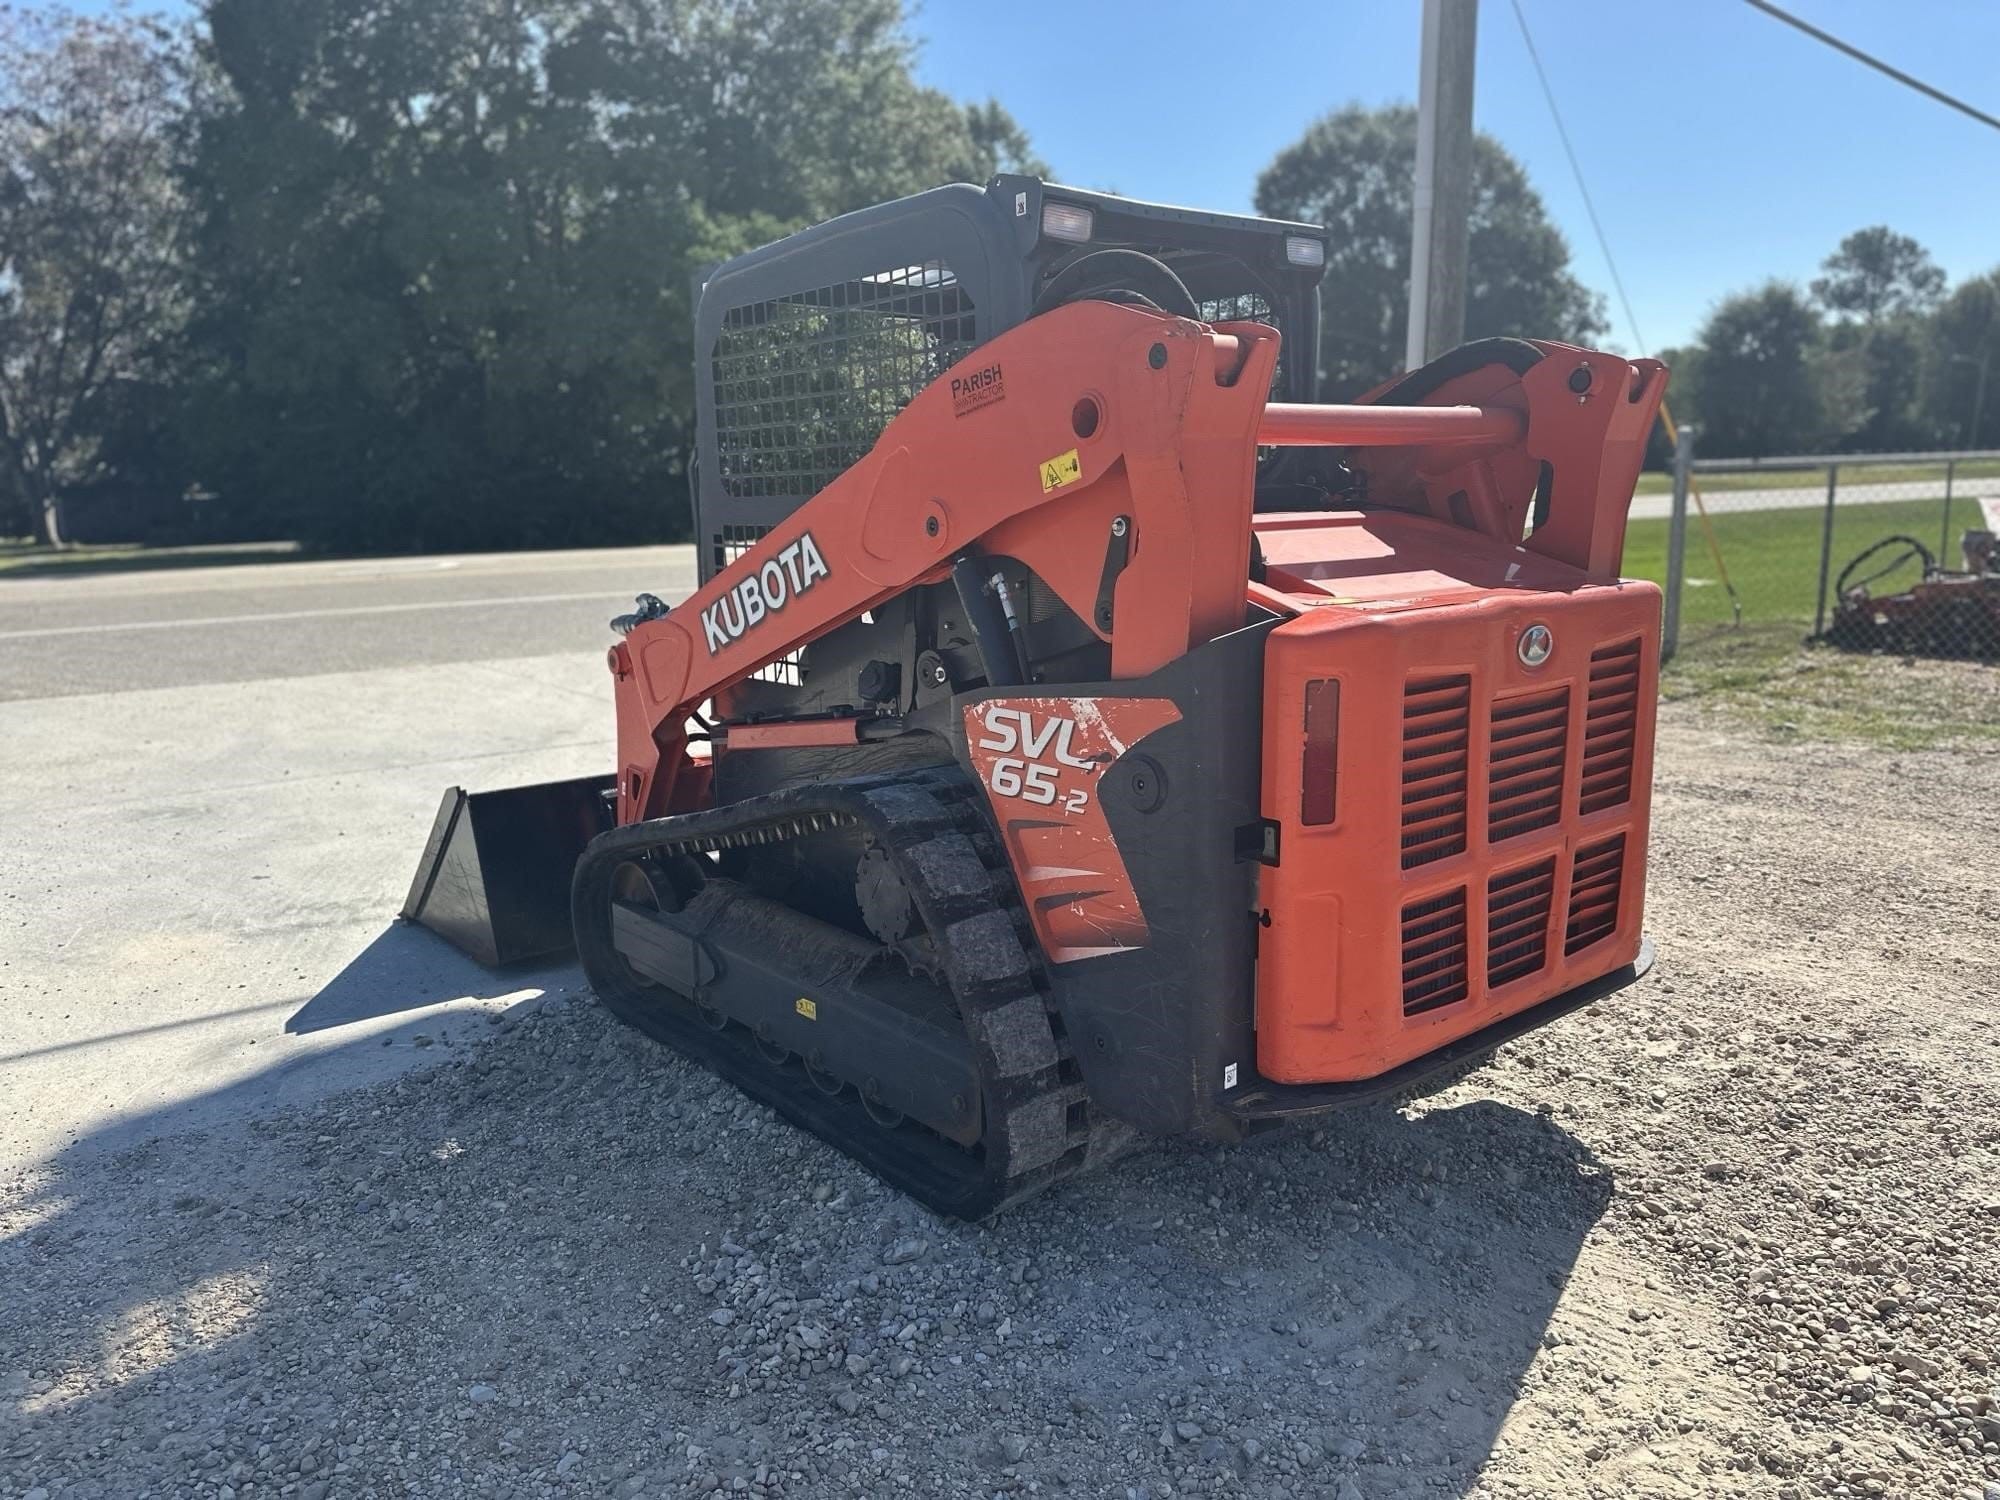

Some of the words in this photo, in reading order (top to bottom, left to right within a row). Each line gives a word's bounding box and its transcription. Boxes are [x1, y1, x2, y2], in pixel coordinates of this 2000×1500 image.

[951, 363, 1003, 400] PARISH
[701, 533, 828, 654] KUBOTA
[979, 707, 1096, 771] SVL
[991, 757, 1089, 815] 65-2
